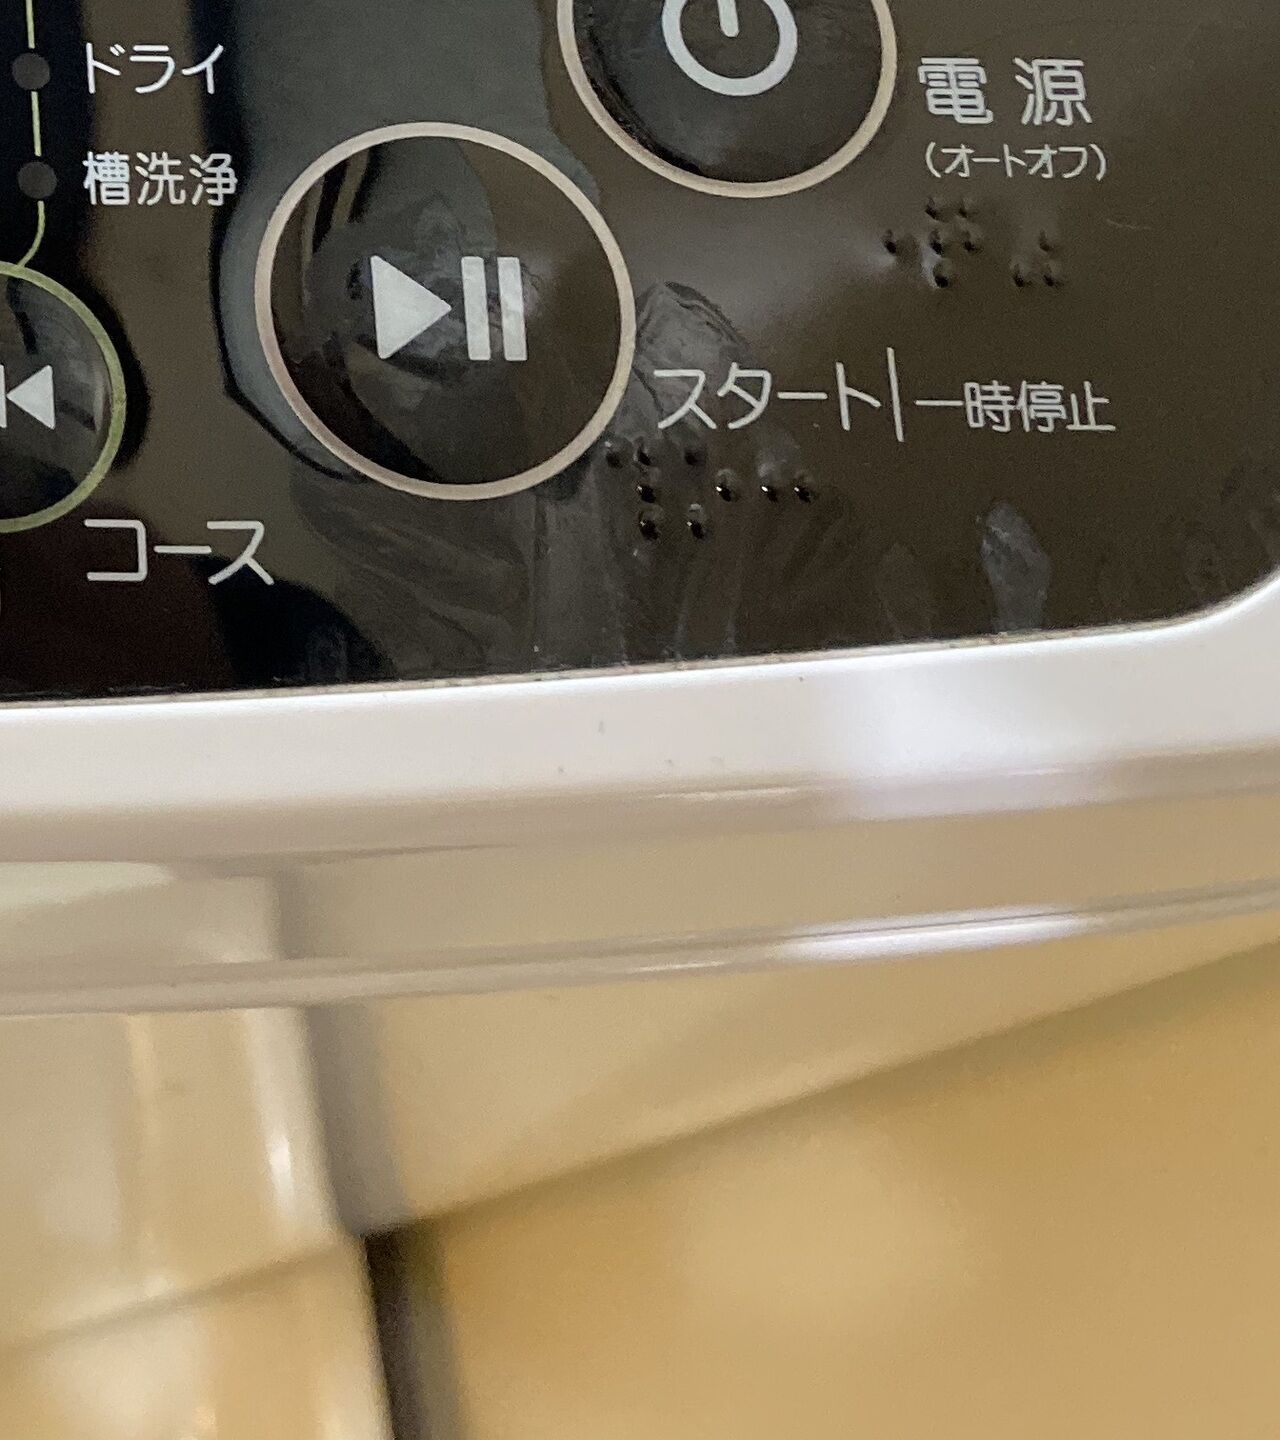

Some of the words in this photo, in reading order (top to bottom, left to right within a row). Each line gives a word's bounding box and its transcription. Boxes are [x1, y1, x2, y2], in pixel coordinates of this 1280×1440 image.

[85, 41, 225, 95] ドライ
[81, 150, 239, 207] 槽洗浄
[82, 517, 275, 586] コース
